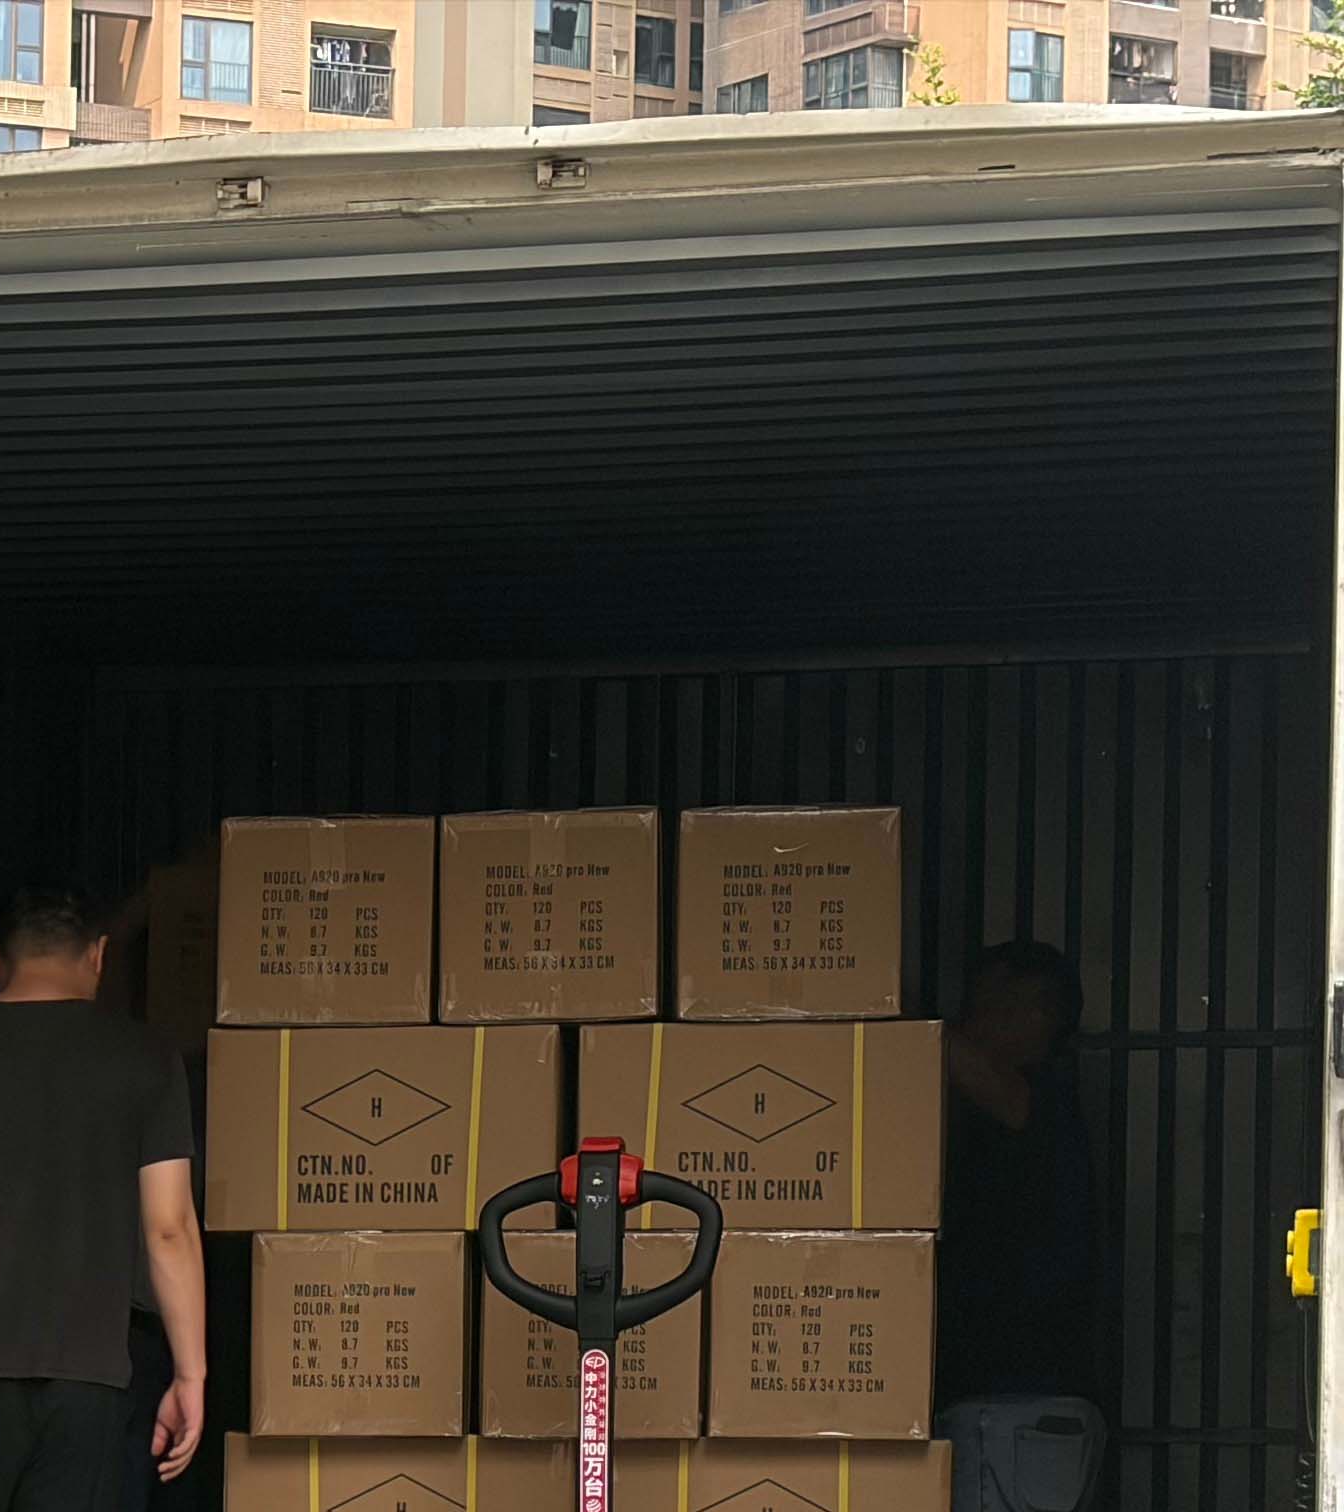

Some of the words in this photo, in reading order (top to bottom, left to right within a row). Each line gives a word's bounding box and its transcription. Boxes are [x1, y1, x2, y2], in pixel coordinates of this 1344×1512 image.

[724, 864, 768, 879] MODEL:
[774, 863, 802, 877] A920
[805, 865, 824, 878] pro
[827, 862, 850, 875] New
[724, 883, 766, 897] COLOR:
[772, 883, 792, 896] Red
[723, 902, 746, 916] QTY:
[772, 901, 791, 914] 120
[820, 900, 844, 914] PCS
[820, 919, 843, 933] KGS
[773, 938, 791, 951] 9.7
[820, 937, 843, 952] KGS
[763, 956, 778, 970] 56
[780, 957, 788, 971] X
[792, 956, 805, 970] 34
[809, 956, 816, 969] X
[820, 956, 833, 970] 33
[838, 955, 855, 970] CM
[371, 1097, 382, 1118] H
[755, 1093, 765, 1114] H
[298, 1154, 373, 1176] CTN.NO.
[431, 1154, 453, 1175] OF
[678, 1152, 755, 1172] CTN.NO.
[816, 1151, 839, 1172] OF
[298, 1183, 349, 1203] MADE
[355, 1182, 378, 1203] IN
[381, 1182, 438, 1203] CHINA
[688, 1179, 731, 1201] ADE
[738, 1180, 756, 1200] IN
[764, 1180, 823, 1200] CHINA
